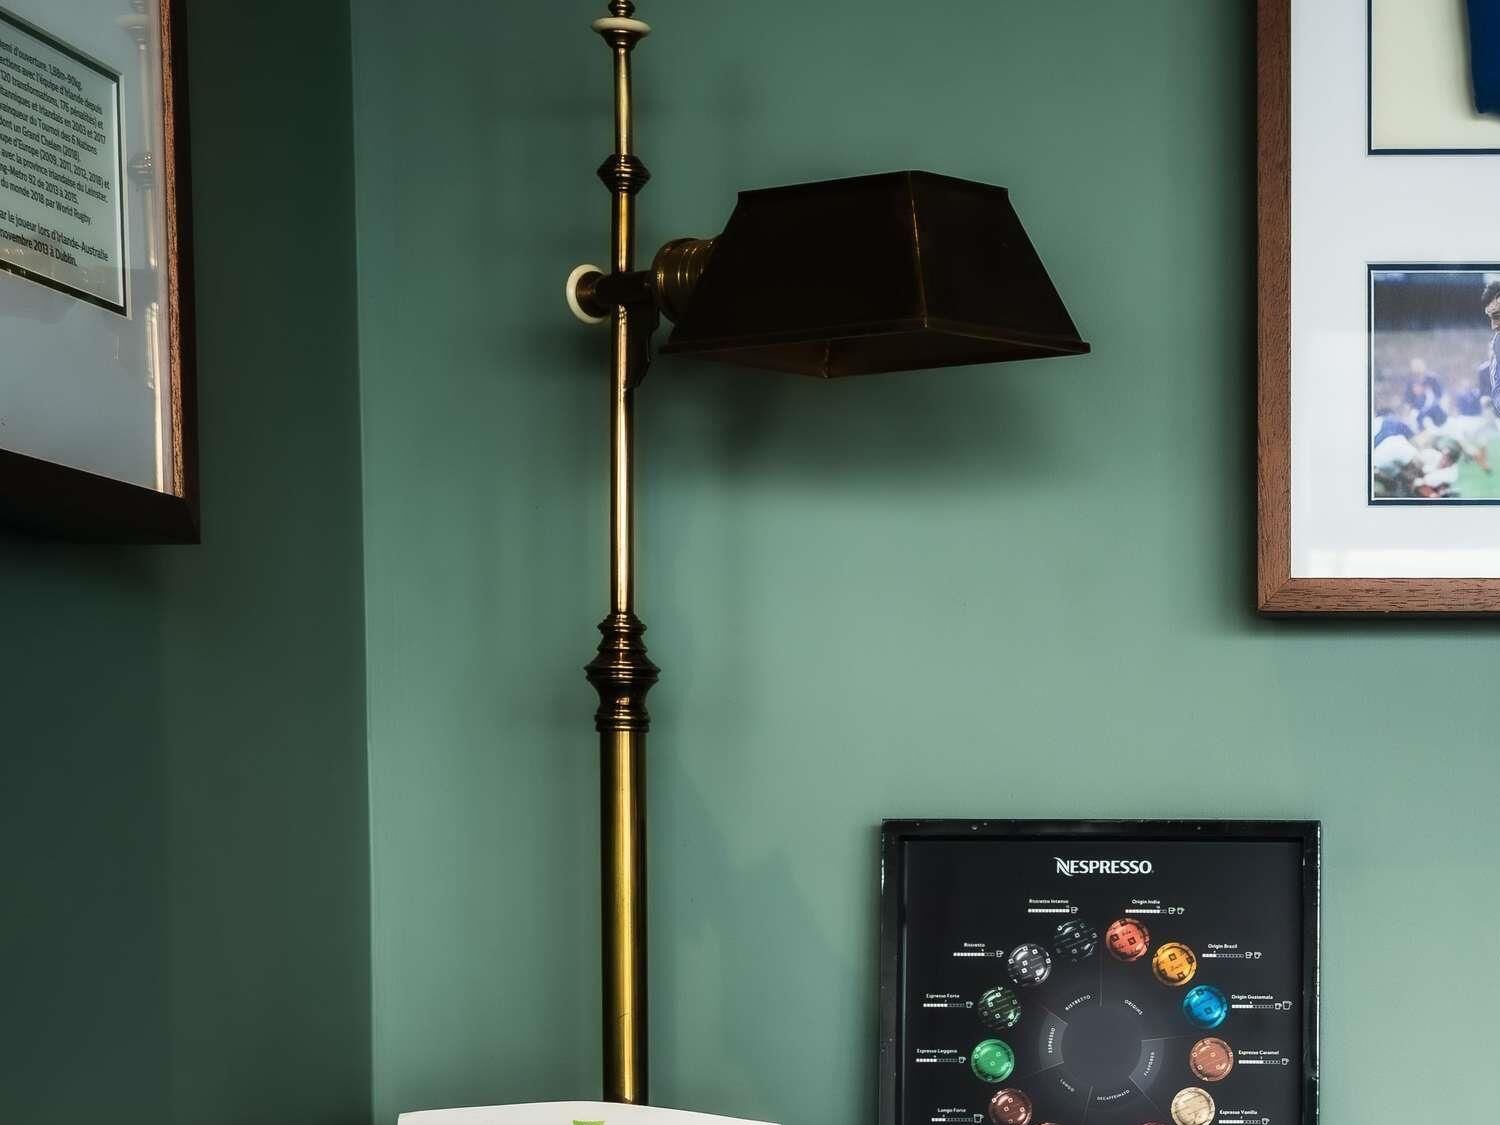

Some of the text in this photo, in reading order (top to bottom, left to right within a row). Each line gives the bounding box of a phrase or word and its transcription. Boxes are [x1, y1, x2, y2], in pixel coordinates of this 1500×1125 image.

[10, 182, 30, 199] monde
[56, 201, 73, 217] World
[37, 223, 50, 238] lors
[1053, 856, 1152, 877] NESPRESSO
